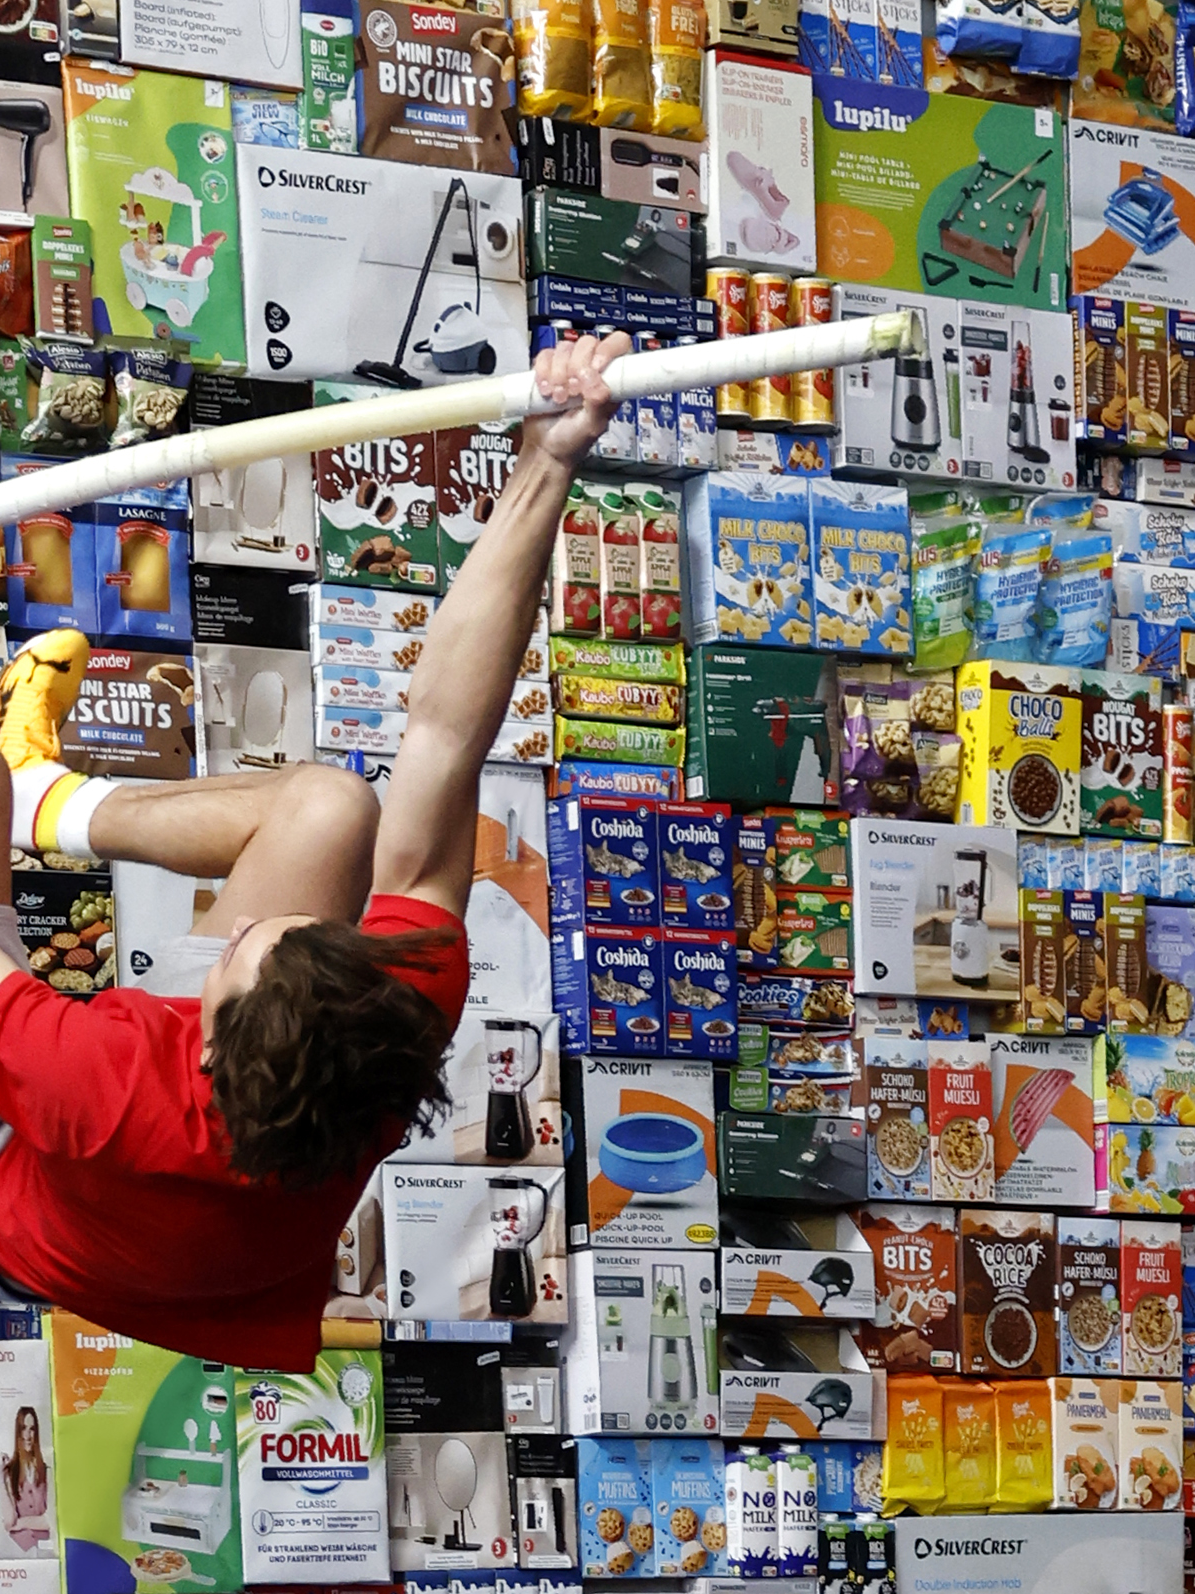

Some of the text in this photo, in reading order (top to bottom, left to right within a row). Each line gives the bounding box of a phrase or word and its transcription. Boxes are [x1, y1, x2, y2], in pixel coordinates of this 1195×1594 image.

[135, 12, 165, 25] Board
[411, 9, 457, 33] Sondey
[135, 35, 152, 47] 305
[165, 39, 177, 49] 79
[188, 44, 198, 52] 12
[201, 46, 218, 55] cm
[396, 41, 473, 74] MINI STAR
[311, 70, 344, 83] MILCH
[75, 77, 132, 102] lupilu
[379, 64, 493, 109] BISCUITS
[406, 109, 467, 127] MILK CHOCOLATE
[834, 100, 906, 133] lupilu
[1096, 130, 1139, 148] CRIVIT
[261, 208, 328, 226] Steam Cleaner
[681, 392, 714, 408] MILCH
[345, 437, 408, 475] BITS
[119, 508, 166, 521] LASAGNE
[409, 503, 430, 517] 42%
[719, 518, 805, 545] MILK CHOCO
[821, 526, 905, 552] MILK CHOCO
[296, 545, 305, 558] 3
[575, 650, 611, 667] Kaubo
[1009, 694, 1062, 720] CHOCO
[1102, 701, 1136, 718] NOUGAT
[80, 729, 100, 738] MILK
[1019, 720, 1054, 738] Balls
[1093, 716, 1144, 746] BITS
[583, 734, 618, 750] Kaubo
[579, 773, 613, 790] Kaubo
[591, 817, 643, 840] Coshida
[668, 823, 719, 845] Coshida
[738, 837, 766, 850] MINIS
[870, 881, 900, 893] Blender
[29, 917, 67, 925] CRACKER
[597, 947, 649, 968] Coshida
[674, 950, 726, 972] Coshida
[1011, 1041, 1050, 1055] CRIVIT
[610, 1063, 652, 1076] CRIVIT
[881, 1073, 915, 1088] SCHOKO
[946, 1074, 974, 1088] FRUIT
[871, 1086, 925, 1103] HAFER-MÜSLI
[944, 1088, 980, 1105] MUESLI
[595, 1235, 629, 1243] PISCINE
[632, 1236, 658, 1244] QUICK
[746, 1255, 782, 1265] CRIVIT
[883, 1246, 932, 1272] BITS
[985, 1244, 1033, 1268] COCOA
[1074, 1252, 1106, 1265] SCHOKO
[1140, 1253, 1165, 1267] FRUIT
[994, 1266, 1027, 1287] RICE
[1063, 1265, 1118, 1280] HAFER-MÜSLI
[1136, 1268, 1171, 1283] MUESLI
[745, 1378, 780, 1388] CRIVIT
[255, 1399, 276, 1421] 80
[262, 1433, 368, 1463] FORMIL
[598, 1482, 637, 1498] MUFFINS
[672, 1481, 711, 1498] MUFFINS
[296, 1500, 337, 1509] CLASSIC
[743, 1510, 775, 1523] MILK
[783, 1510, 817, 1522] MILK
[495, 1541, 505, 1555] 3
[269, 1555, 284, 1563] UND
[333, 1554, 367, 1563] REINHEIT
[915, 1579, 951, 1590] Double
